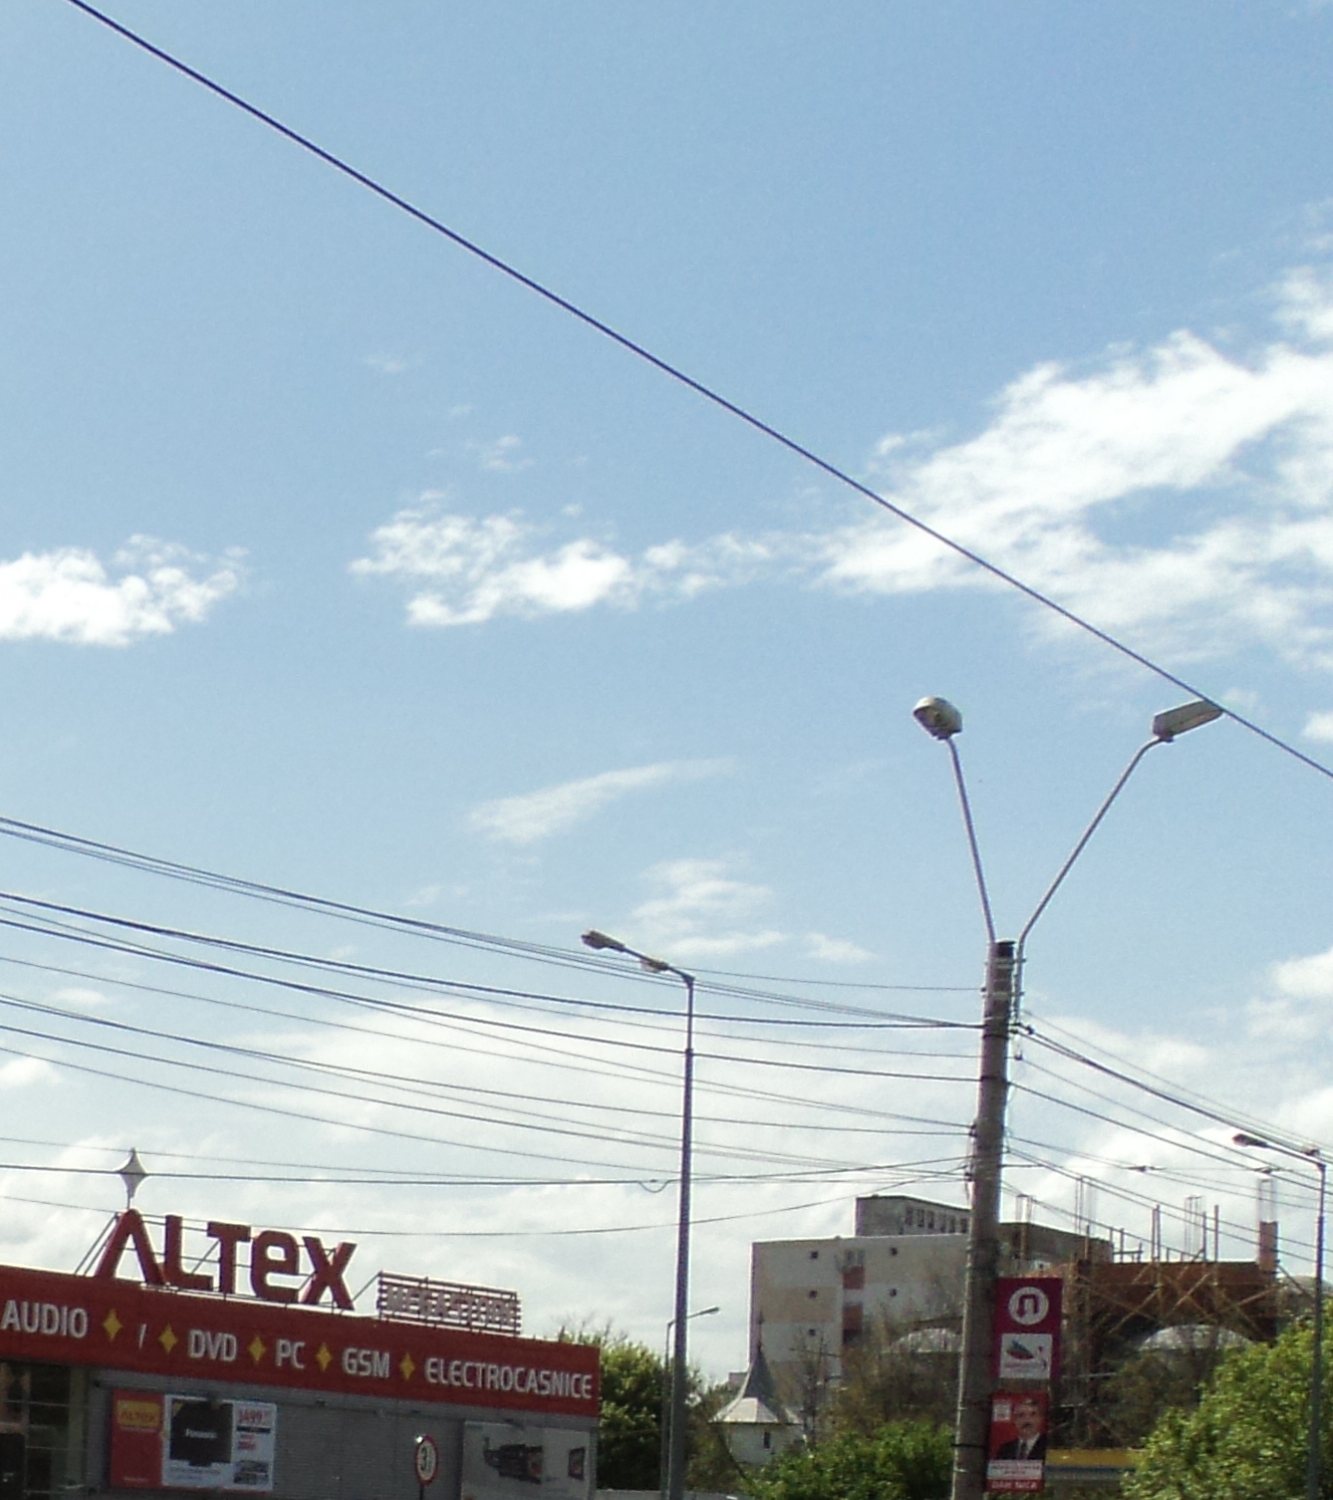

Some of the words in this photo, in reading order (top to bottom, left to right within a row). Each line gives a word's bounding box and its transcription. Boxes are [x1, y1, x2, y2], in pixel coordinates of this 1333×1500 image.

[0, 1300, 88, 1338] AUDIO
[188, 1330, 238, 1362] DVD
[275, 1339, 306, 1368] PC
[342, 1348, 391, 1379] GSM
[424, 1357, 593, 1400] ELECTROCASNICE
